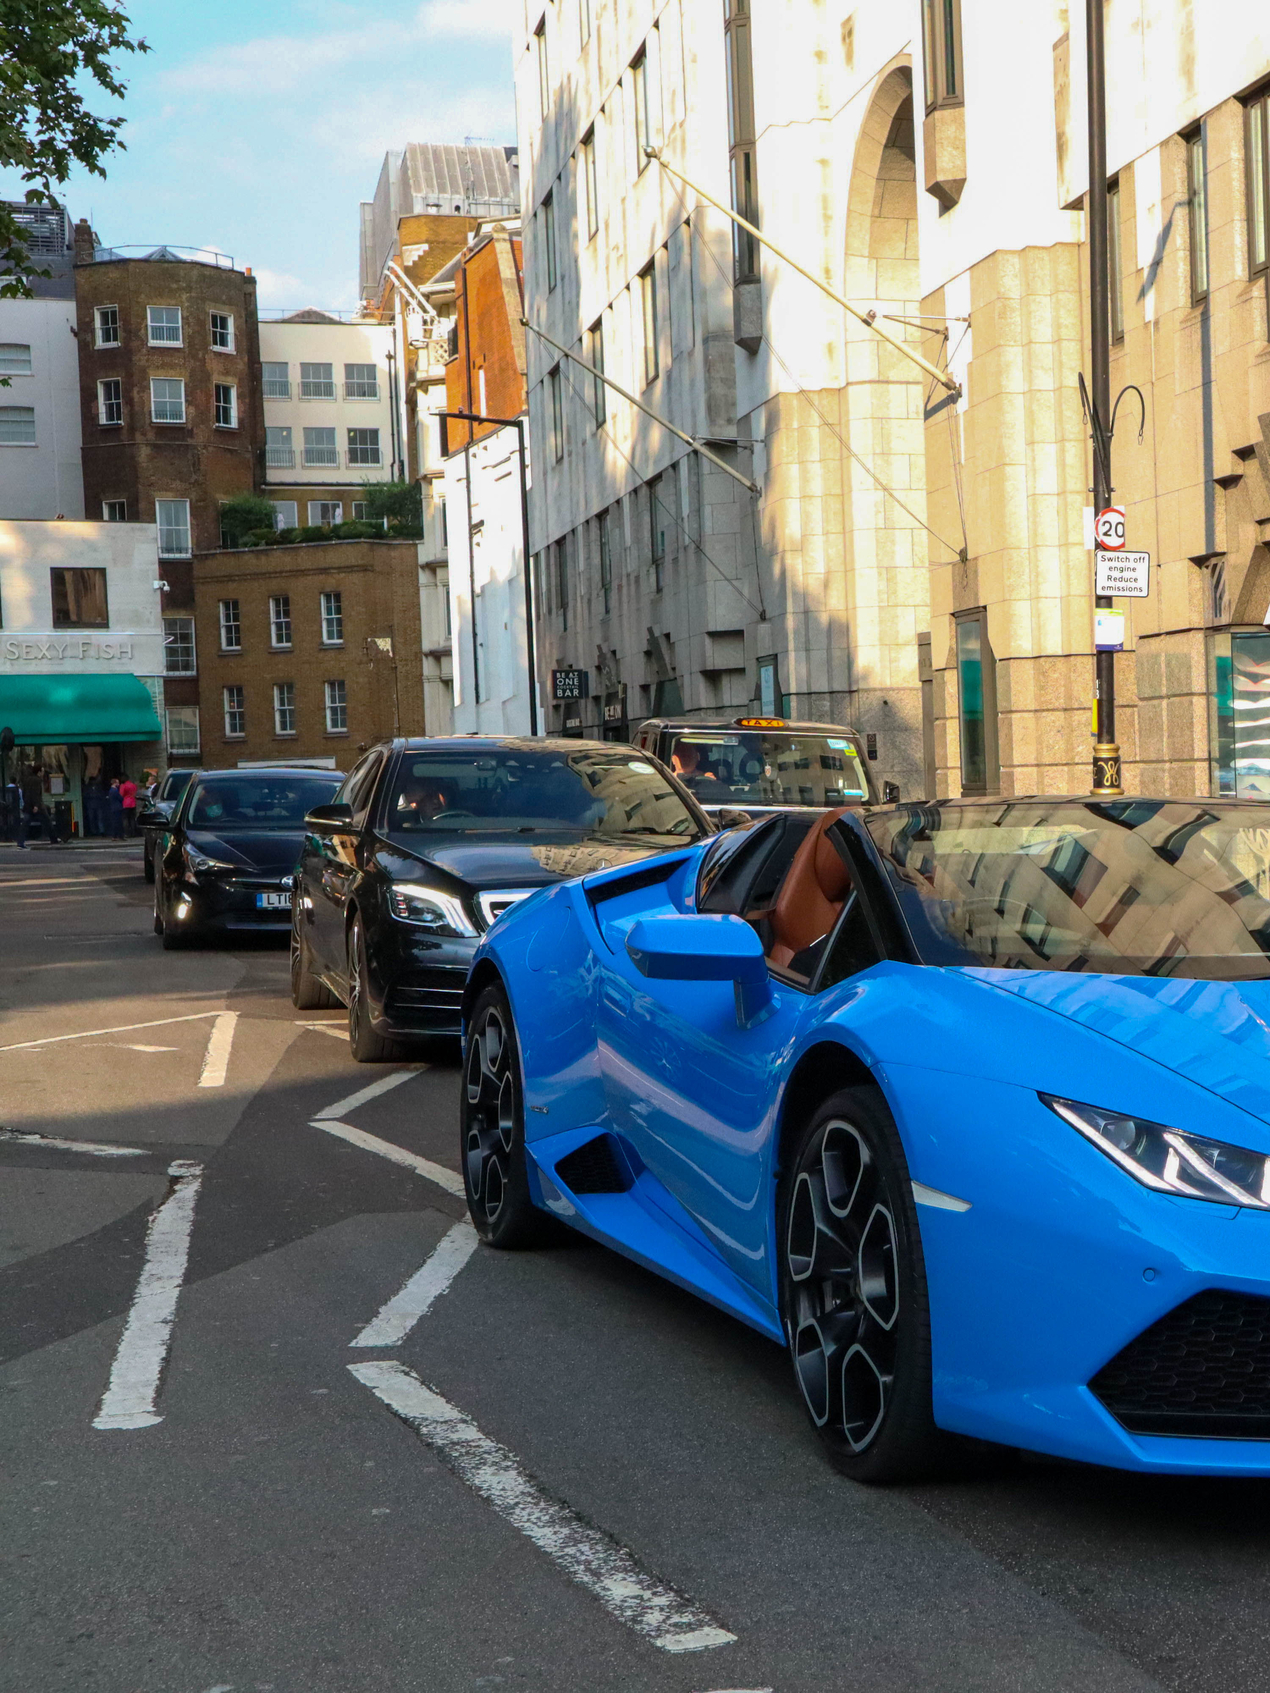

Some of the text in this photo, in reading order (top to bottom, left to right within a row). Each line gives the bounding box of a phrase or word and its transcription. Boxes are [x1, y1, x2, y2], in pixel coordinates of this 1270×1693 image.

[1102, 521, 1124, 538] 20
[1101, 555, 1131, 563] Switch
[1108, 565, 1137, 573] engine
[1107, 575, 1138, 583] Reduce
[1101, 585, 1143, 593] emissions
[6, 640, 134, 660] SEXY FISH
[556, 678, 579, 686] ONE
[556, 688, 579, 697] BAR
